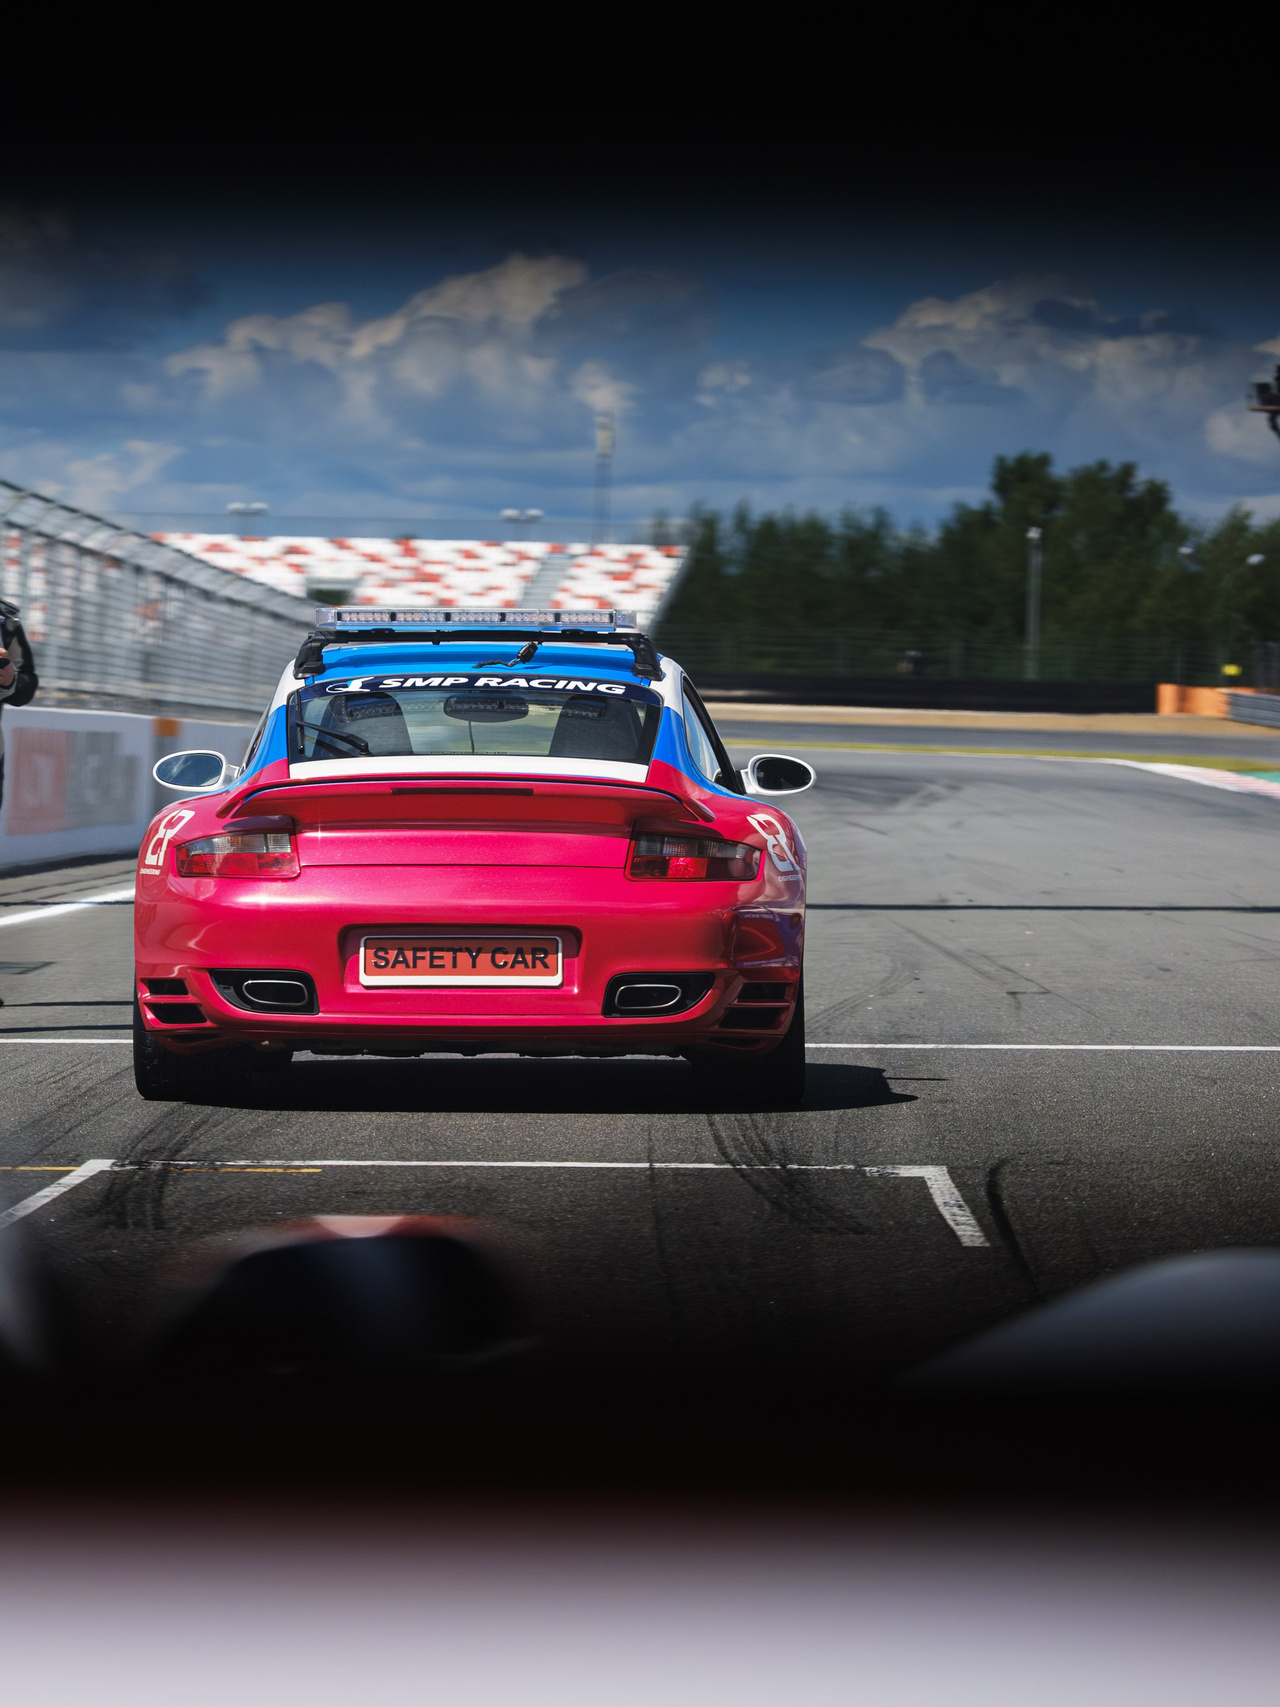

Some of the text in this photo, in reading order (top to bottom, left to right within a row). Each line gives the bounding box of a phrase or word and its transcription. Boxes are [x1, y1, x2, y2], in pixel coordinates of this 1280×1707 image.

[378, 676, 626, 695] SMP RACING
[371, 946, 550, 969] SAFETY CAR
